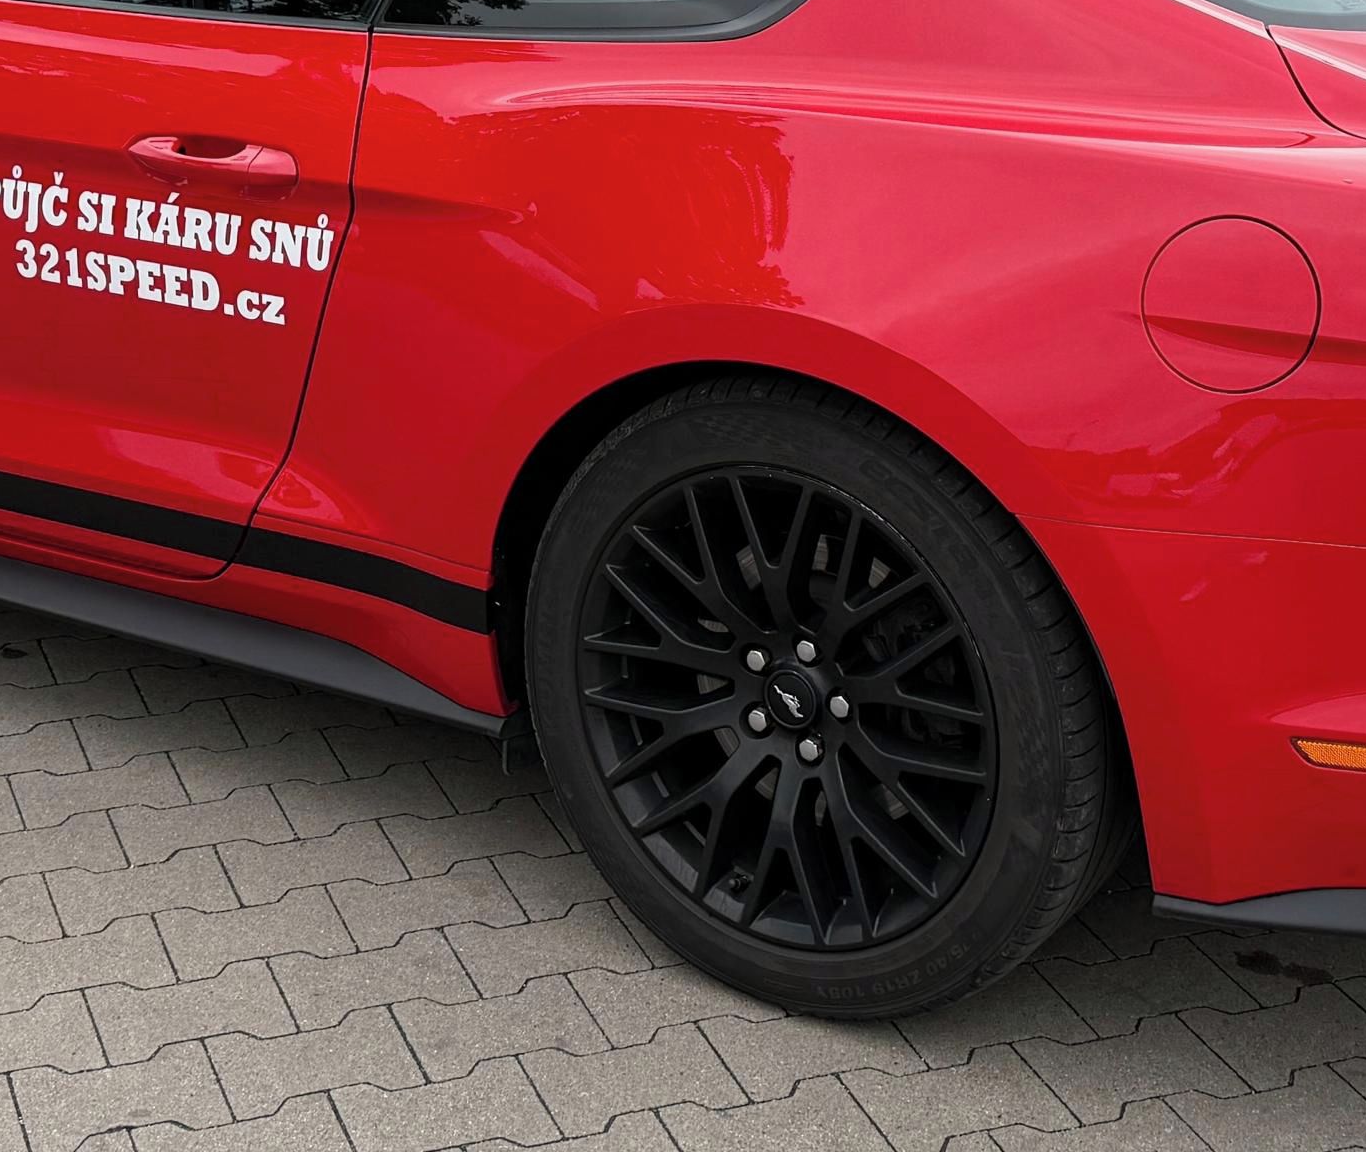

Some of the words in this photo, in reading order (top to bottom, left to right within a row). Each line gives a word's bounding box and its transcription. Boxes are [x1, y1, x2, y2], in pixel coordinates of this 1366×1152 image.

[77, 190, 117, 235] SI
[124, 192, 242, 256] KÁRU
[249, 214, 335, 271] SNŮ
[15, 239, 286, 326] 321SPEED.cz
